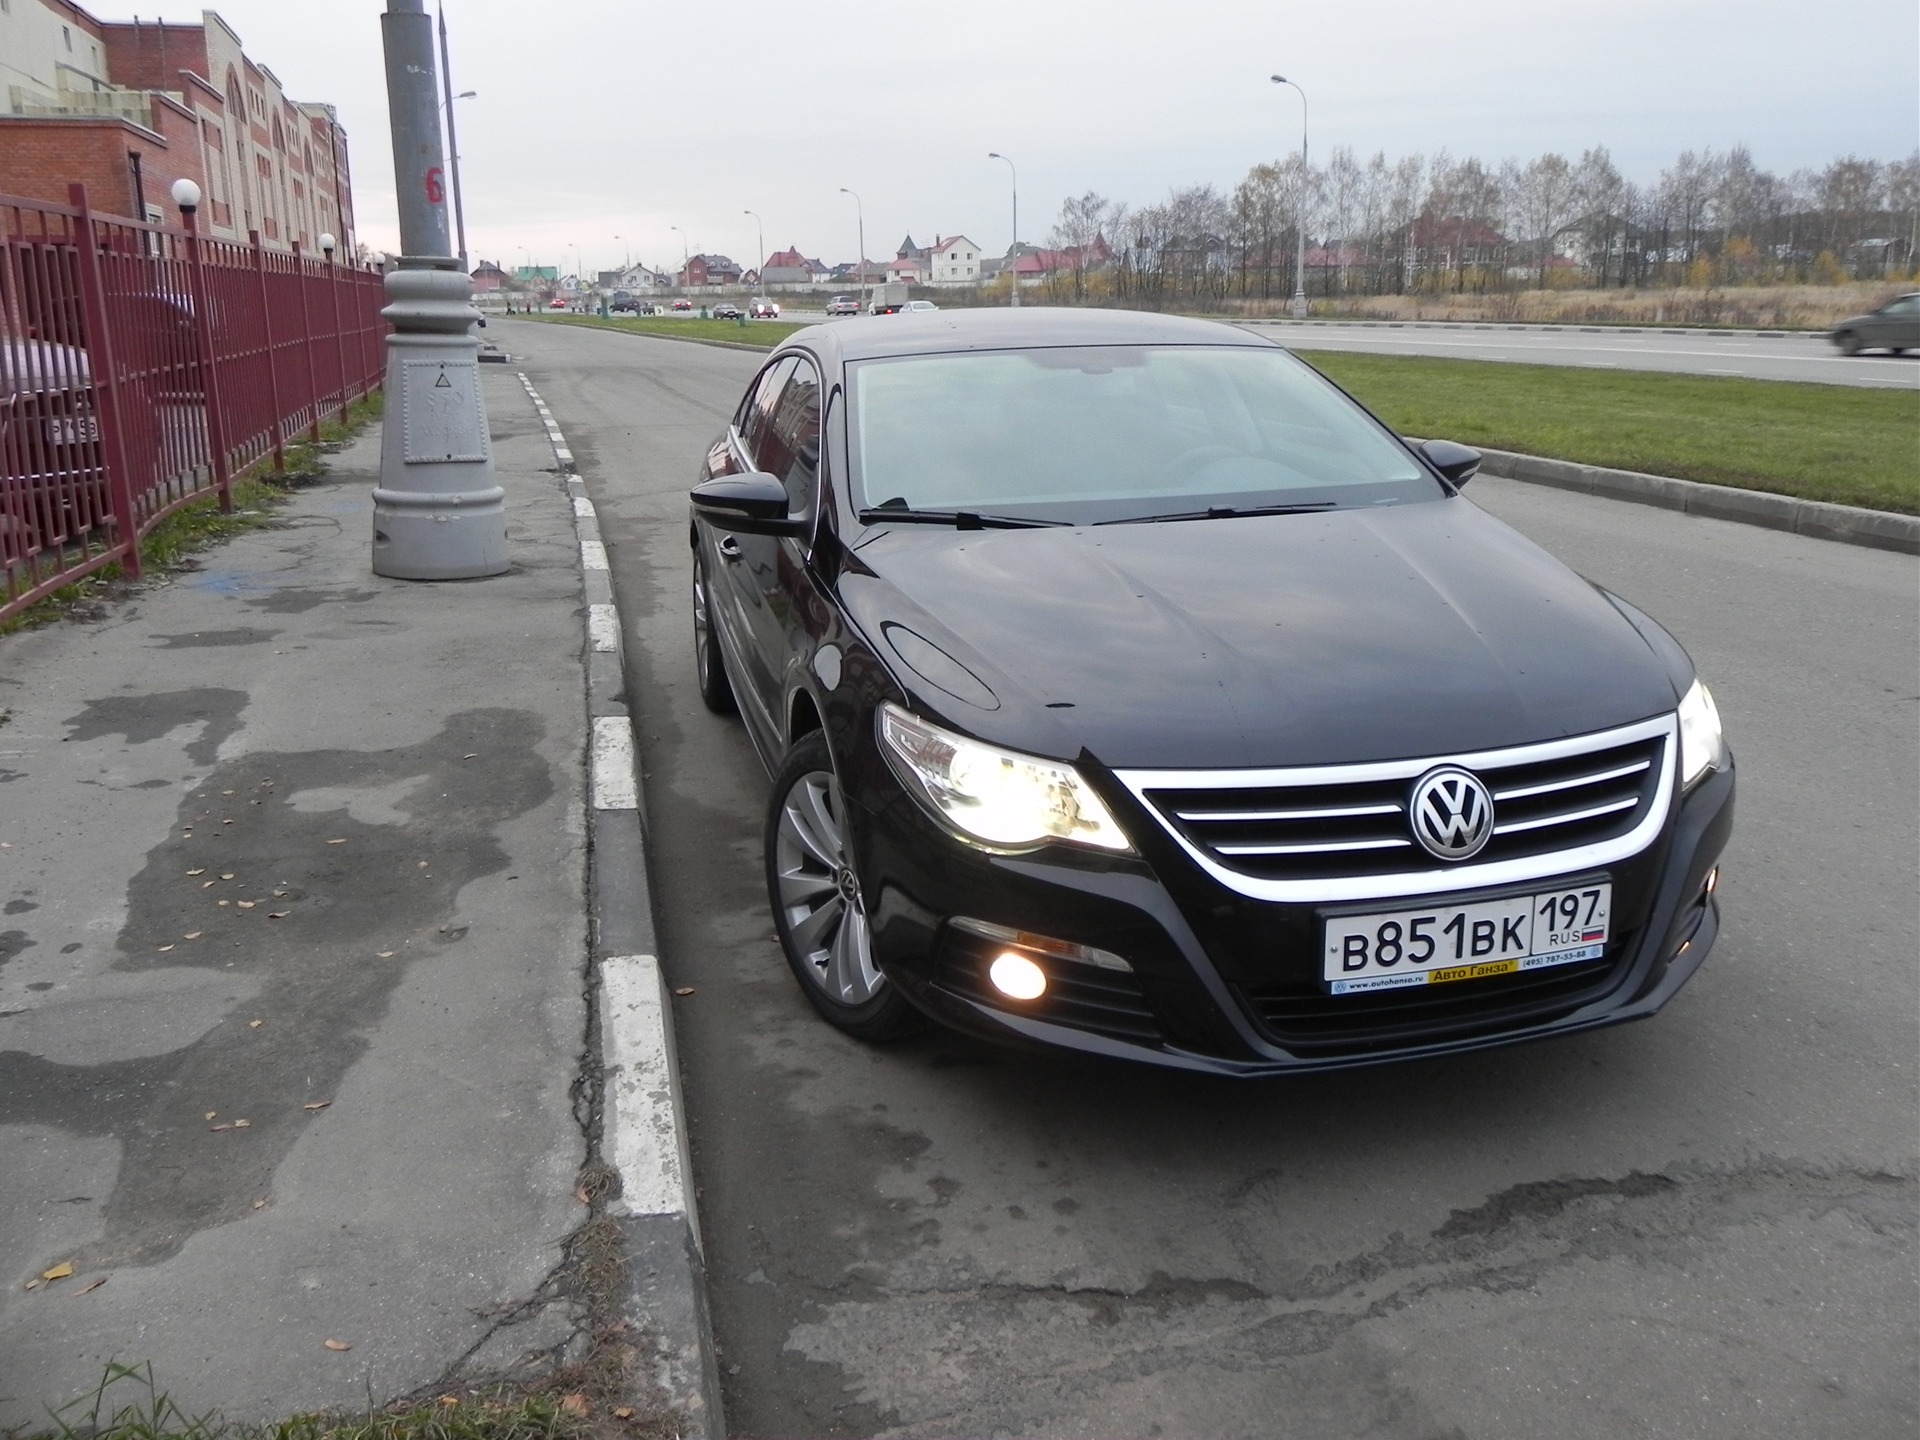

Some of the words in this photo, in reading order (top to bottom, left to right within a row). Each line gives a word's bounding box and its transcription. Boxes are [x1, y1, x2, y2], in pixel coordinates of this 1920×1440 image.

[425, 167, 443, 204] 6
[1539, 889, 1601, 932] 197
[1343, 912, 1526, 972] В851ВК
[1549, 930, 1580, 946] RUS
[1522, 957, 1544, 968] (495)
[1546, 950, 1586, 963] 787-55-88
[1349, 975, 1424, 990] www.autohansa.ru
[1433, 969, 1466, 982] Авто
